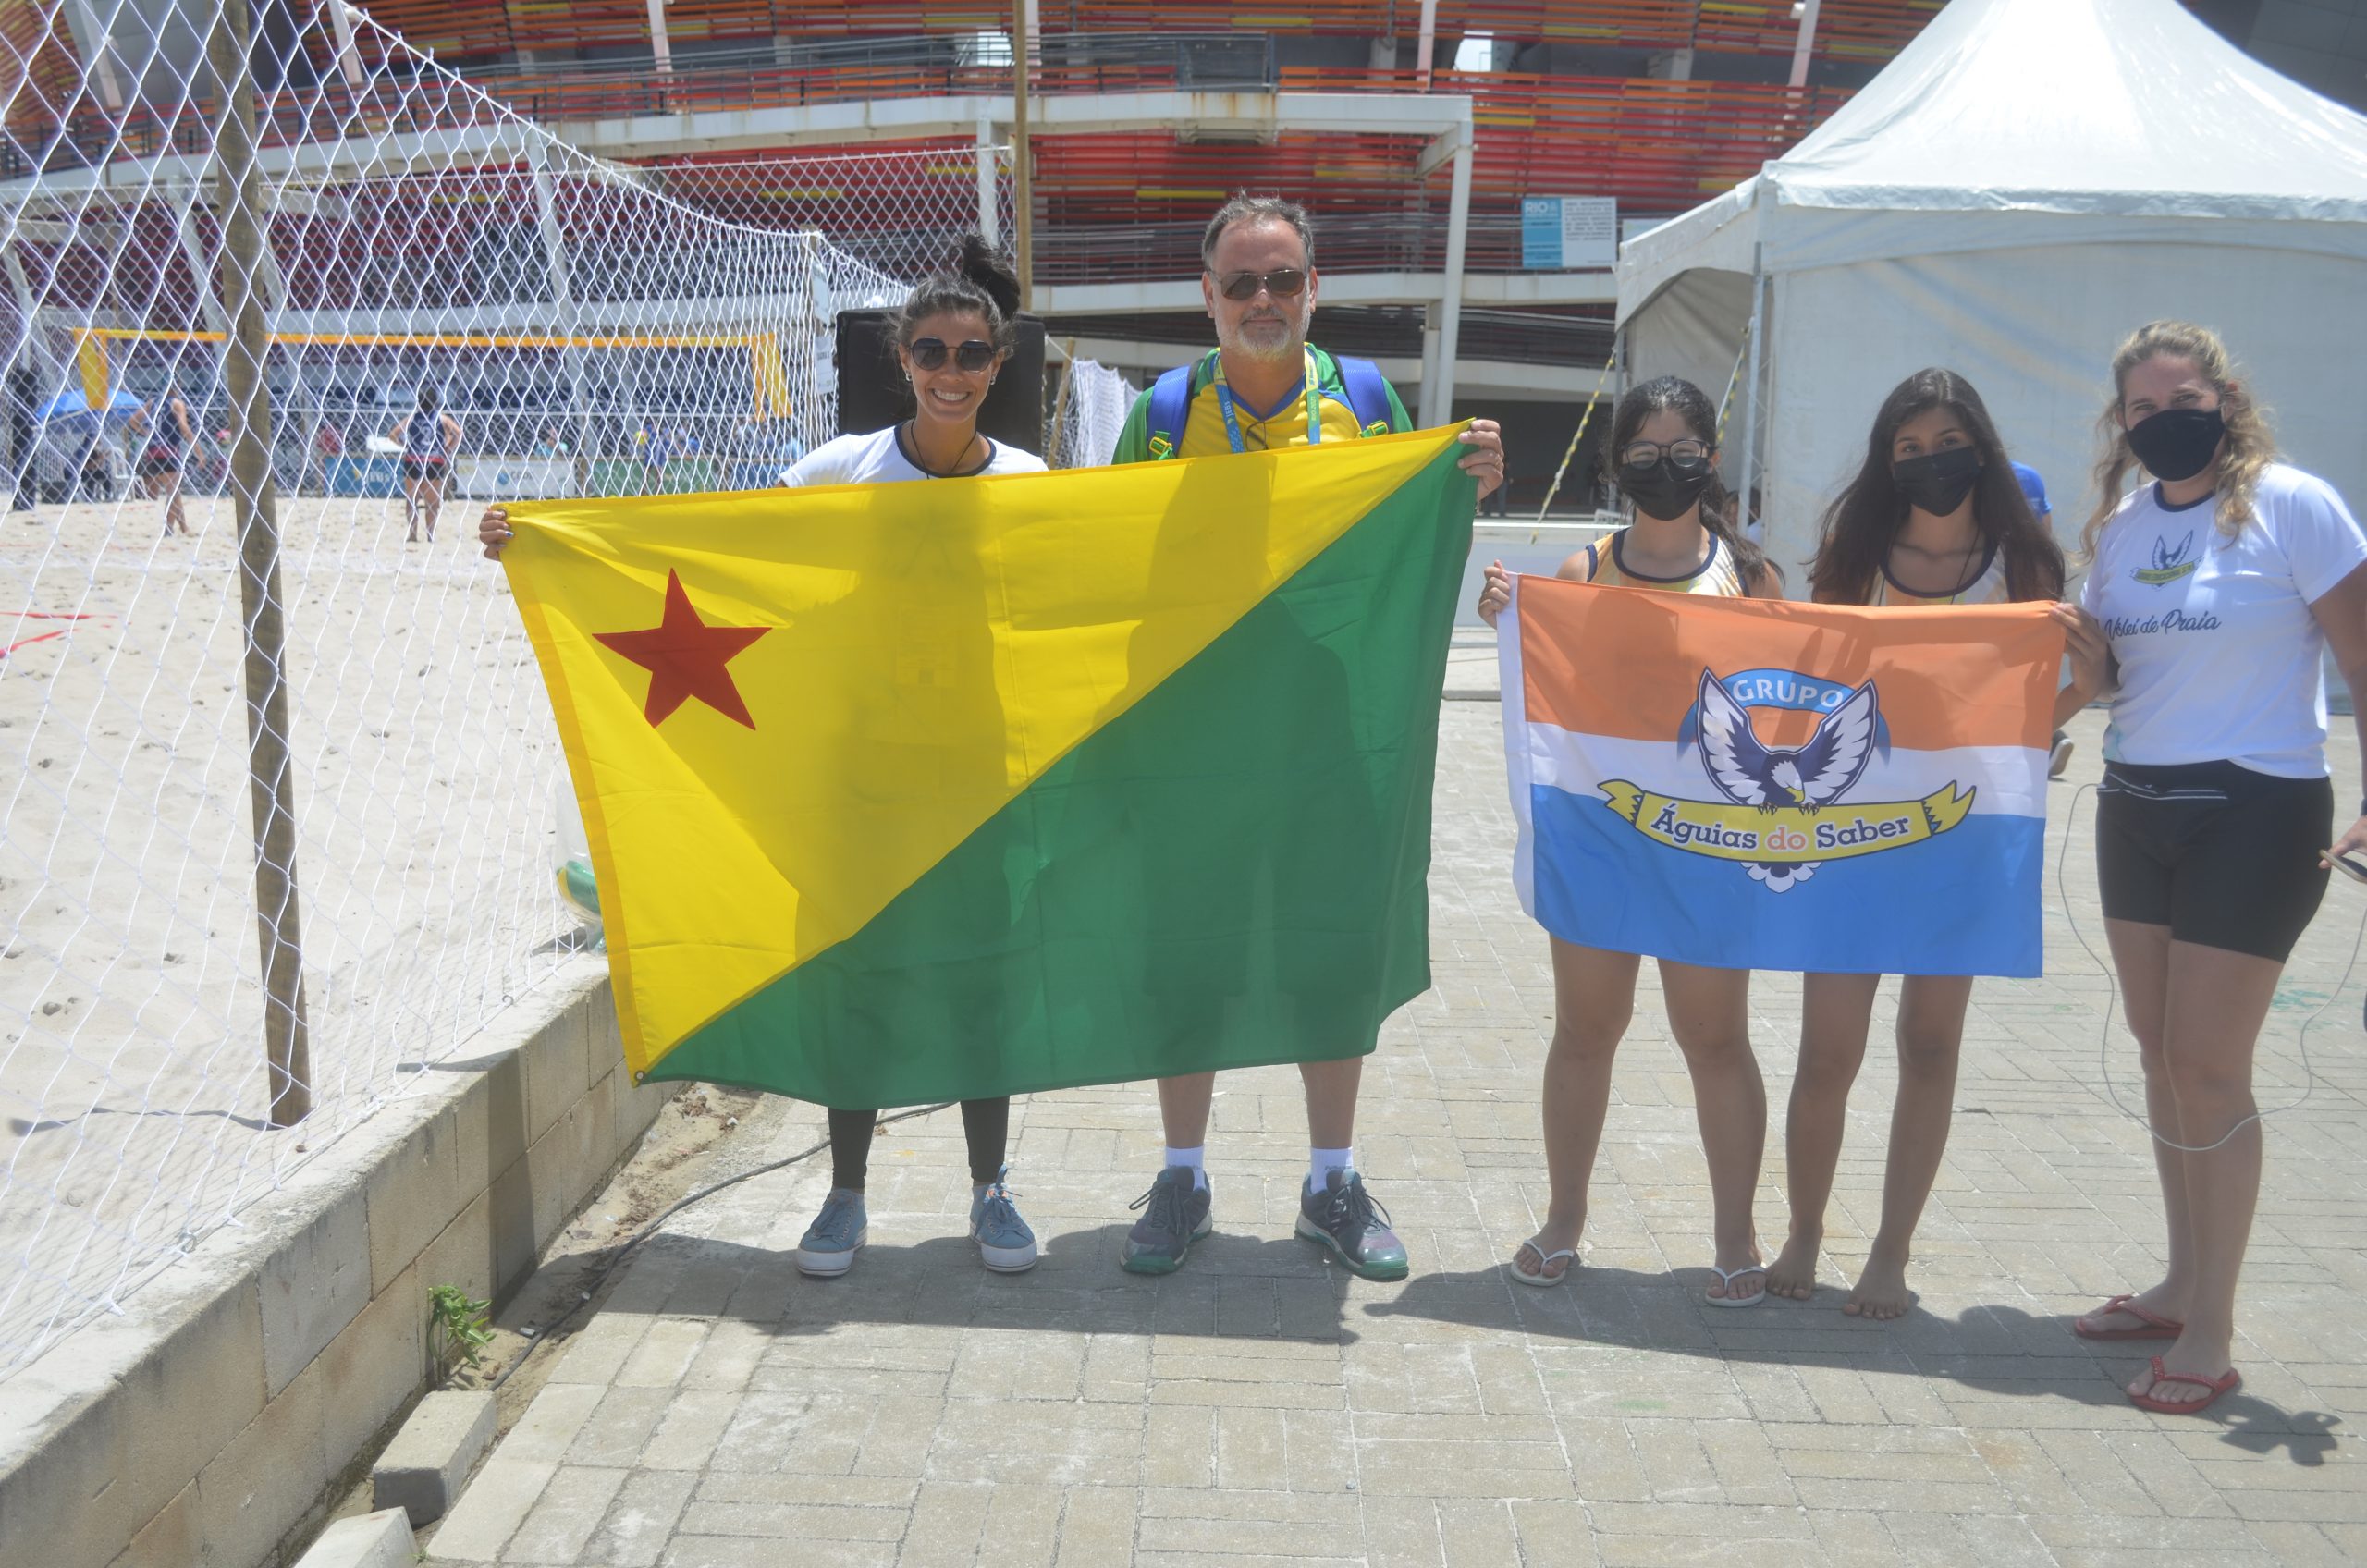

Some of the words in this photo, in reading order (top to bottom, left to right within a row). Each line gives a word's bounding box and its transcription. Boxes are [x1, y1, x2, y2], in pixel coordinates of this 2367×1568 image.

[2140, 615, 2159, 634] de
[2161, 609, 2222, 635] Praia
[1732, 678, 1843, 708] GRUPO
[1650, 802, 1757, 850] Águias
[1767, 827, 1806, 851] do
[1815, 817, 1909, 849] Saber
